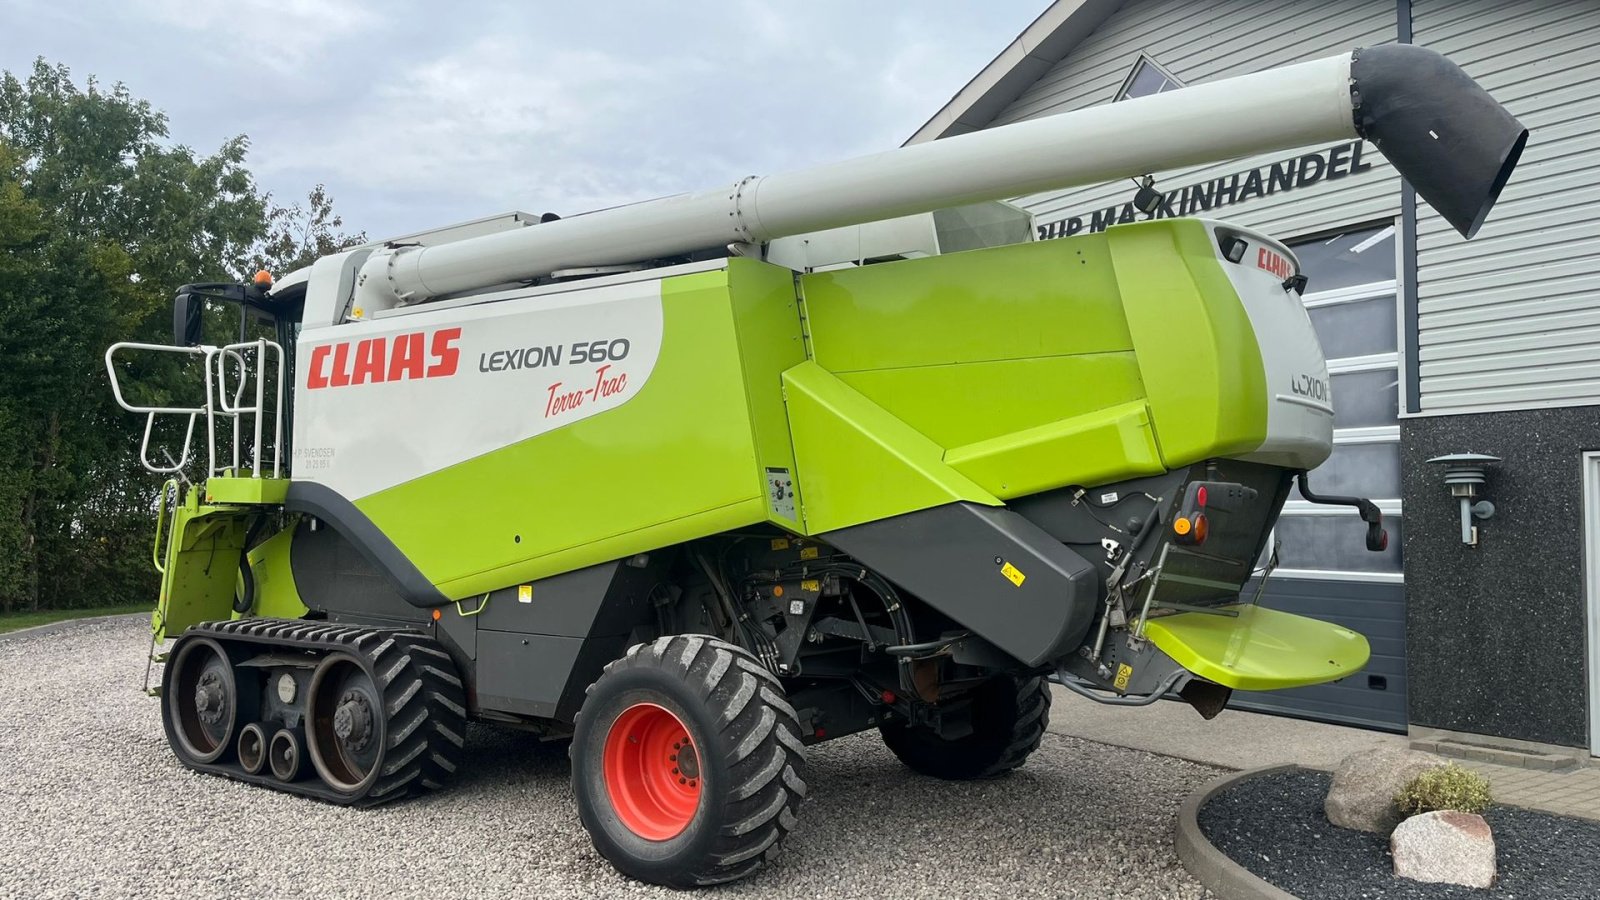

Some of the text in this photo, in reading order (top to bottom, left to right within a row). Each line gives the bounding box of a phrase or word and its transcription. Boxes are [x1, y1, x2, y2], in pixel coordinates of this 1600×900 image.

[307, 327, 462, 390] CLAAS
[479, 338, 630, 373] LEXION 560
[545, 364, 627, 418] Terra-Trac
